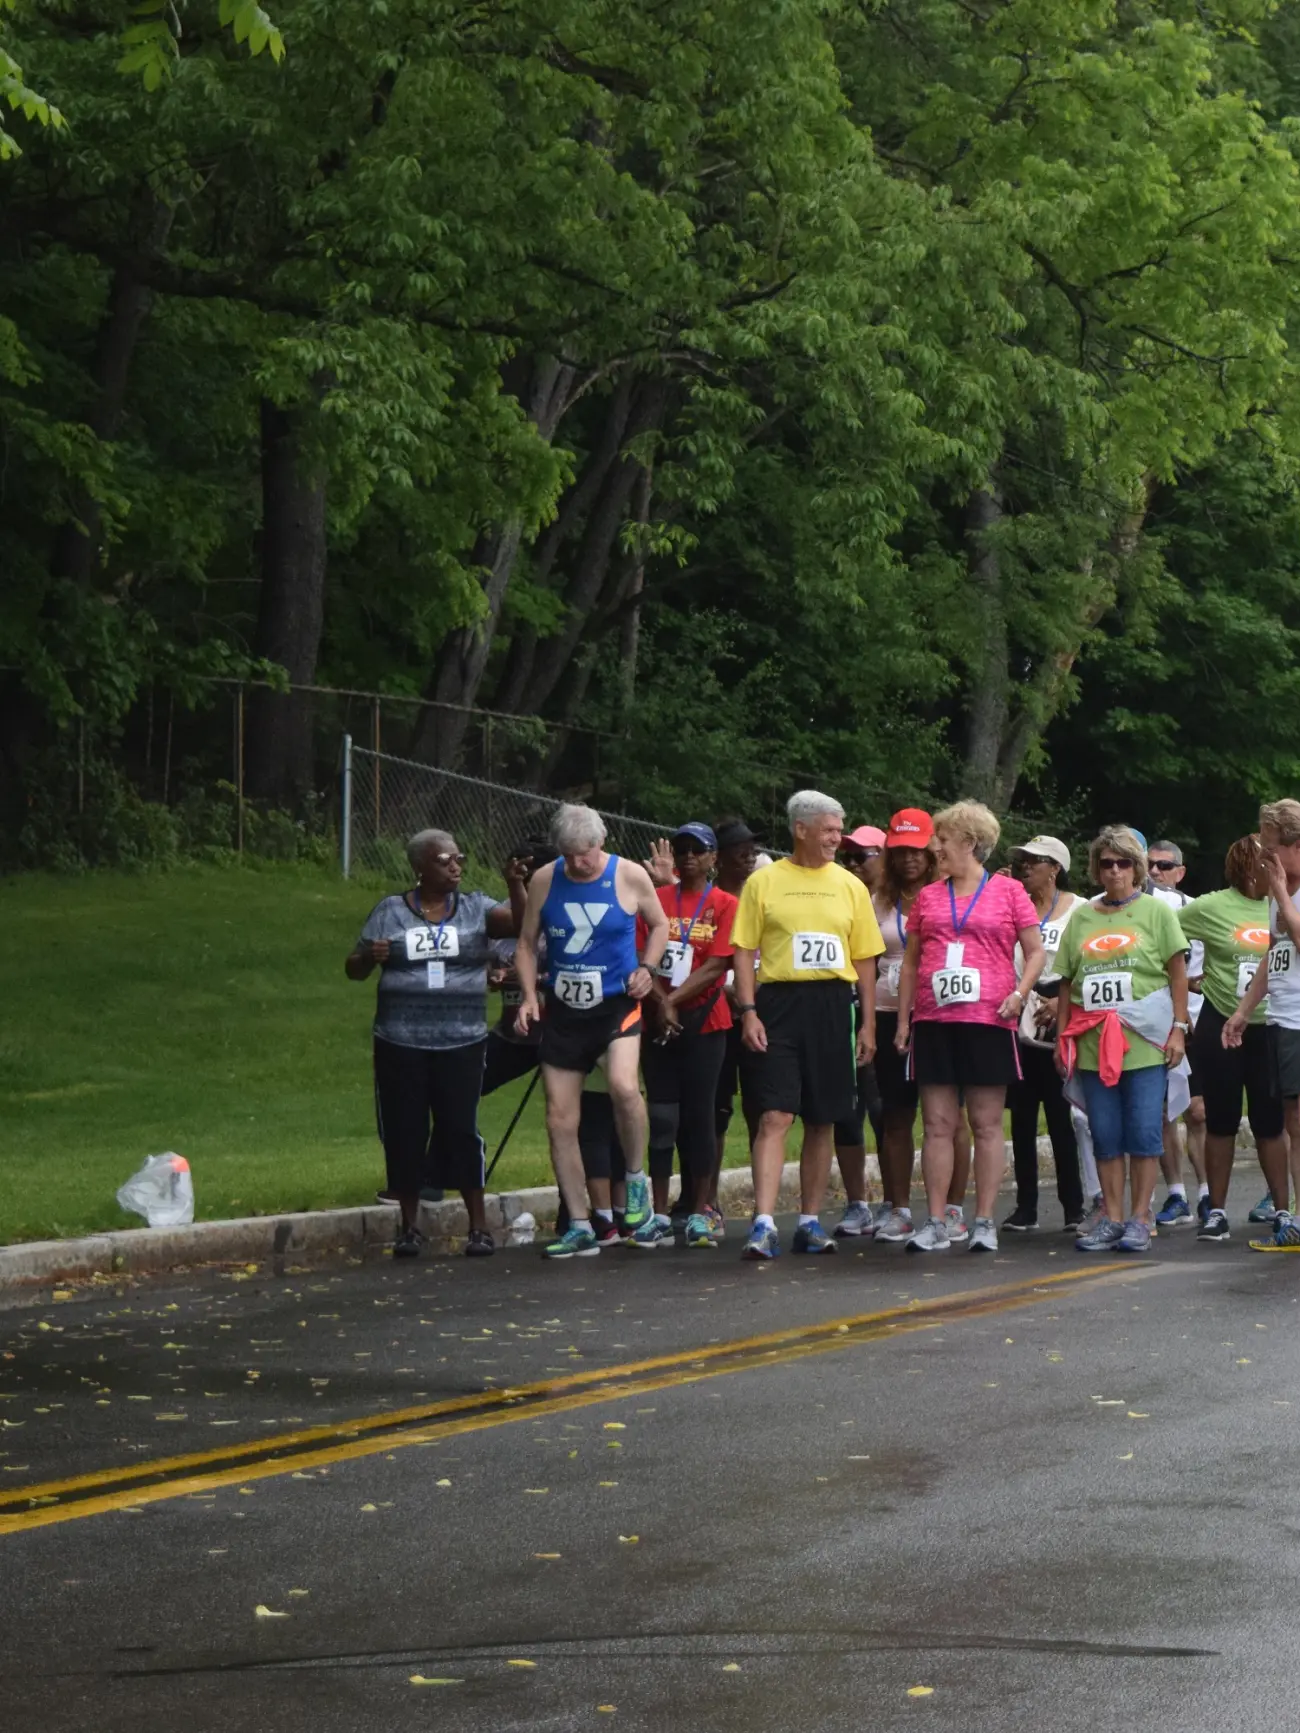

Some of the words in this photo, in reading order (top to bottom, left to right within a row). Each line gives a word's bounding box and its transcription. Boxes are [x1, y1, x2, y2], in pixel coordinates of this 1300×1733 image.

[415, 932, 451, 953] 252
[1040, 928, 1059, 944] 59
[802, 940, 836, 963] 270
[1269, 949, 1290, 973] 269
[580, 963, 608, 972] Runners
[1082, 960, 1118, 972] Cortland
[1119, 958, 1138, 967] 2017
[562, 980, 594, 1003] 273
[939, 975, 972, 999] 266
[1091, 980, 1124, 1004] 261
